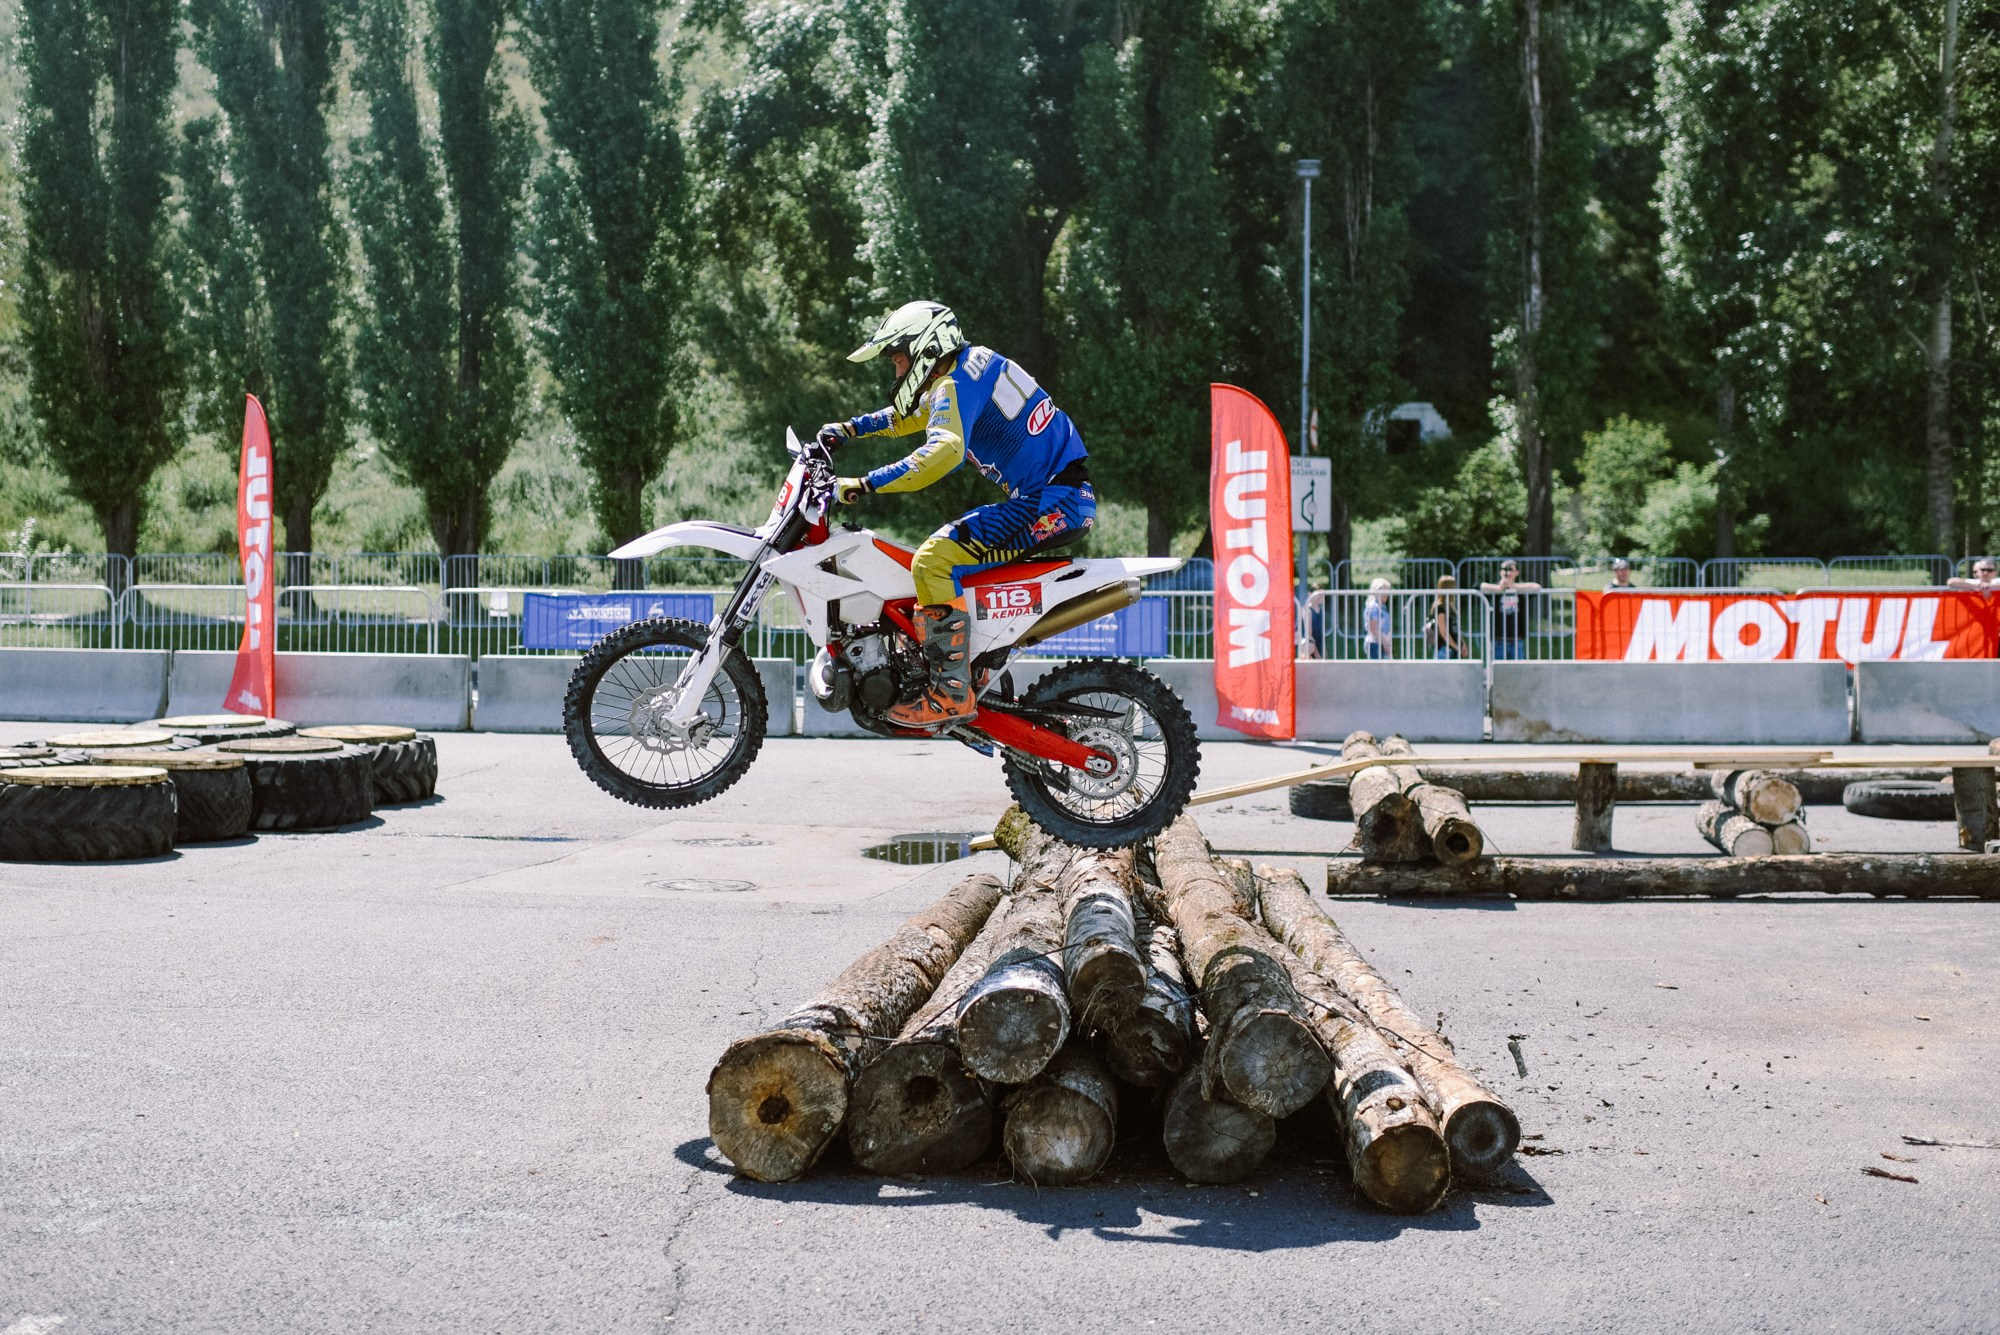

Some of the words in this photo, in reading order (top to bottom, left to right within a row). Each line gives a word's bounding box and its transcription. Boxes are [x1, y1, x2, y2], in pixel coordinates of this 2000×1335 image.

[985, 589, 1032, 609] 118
[992, 608, 1031, 619] KENDA
[1624, 598, 1950, 663] MOTUL
